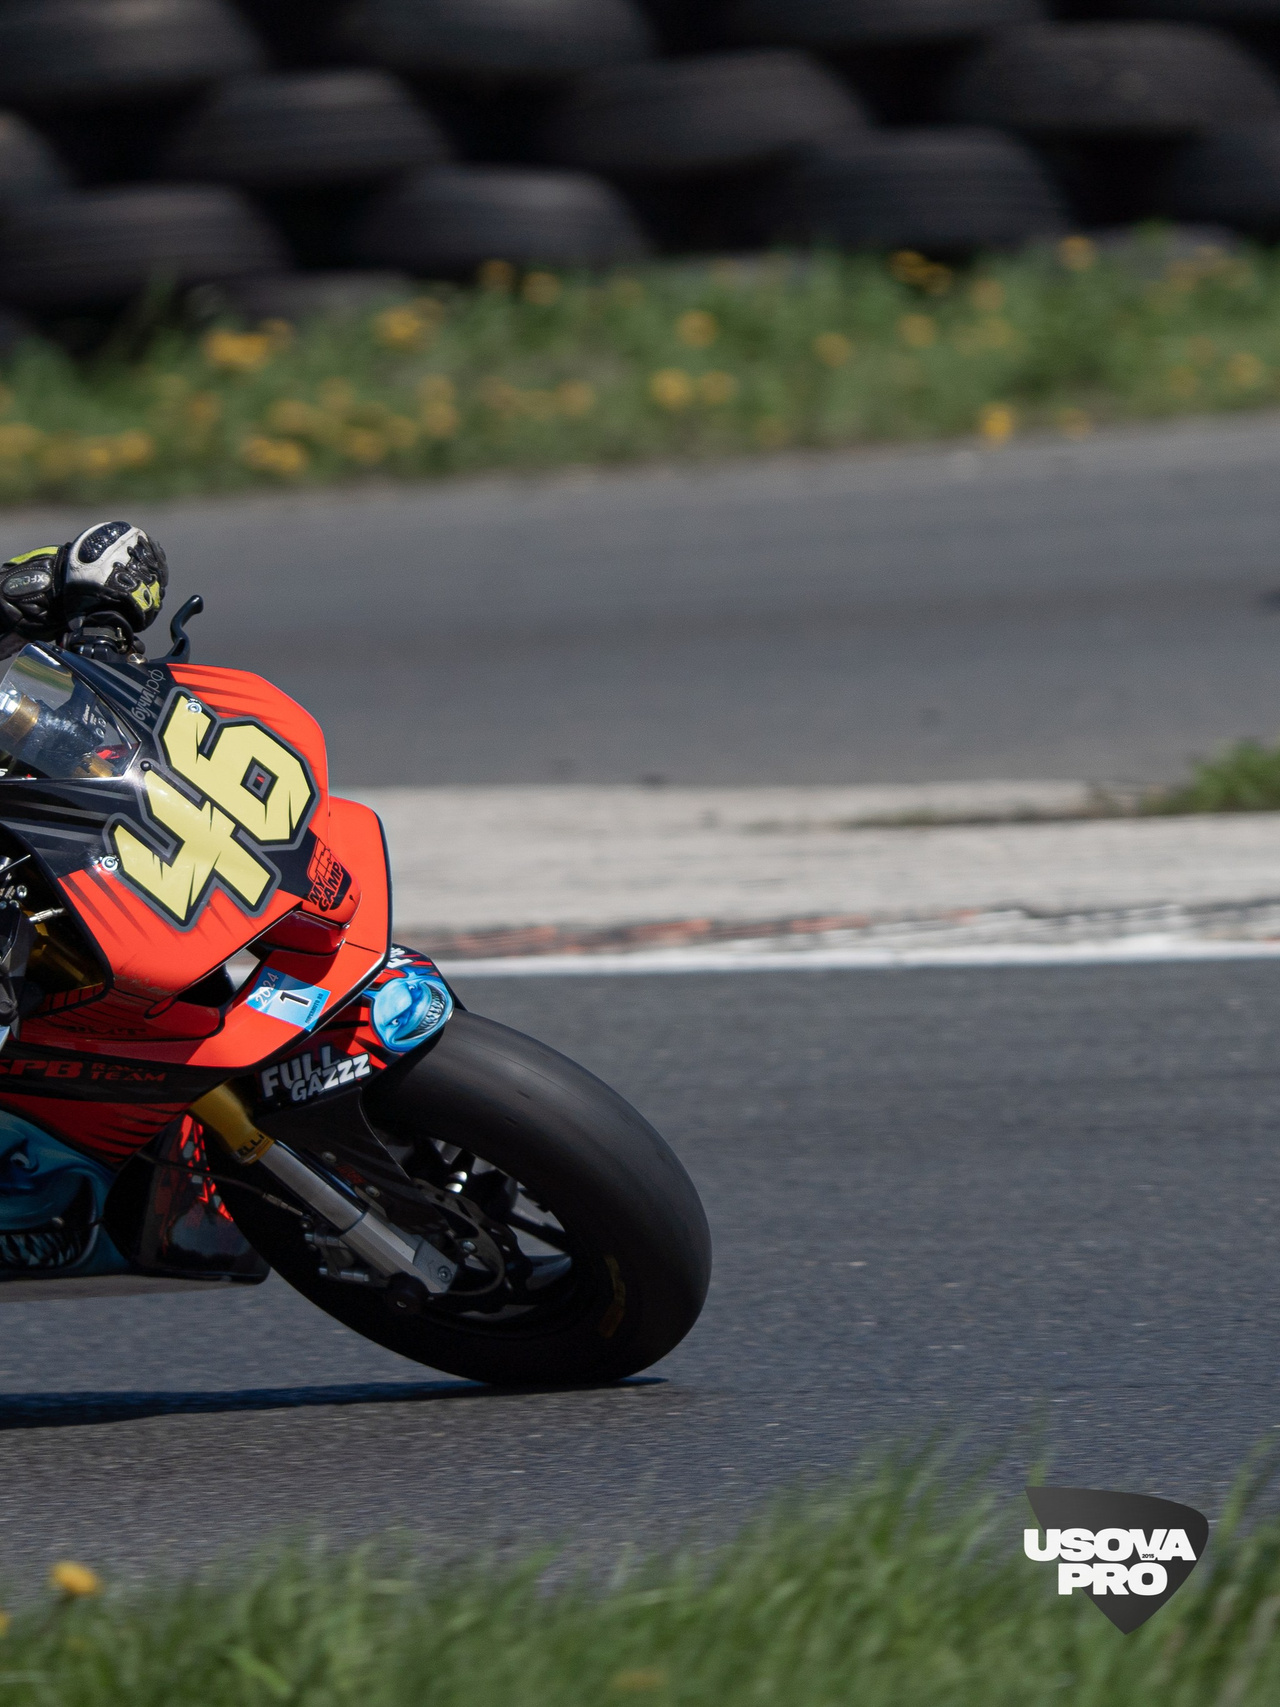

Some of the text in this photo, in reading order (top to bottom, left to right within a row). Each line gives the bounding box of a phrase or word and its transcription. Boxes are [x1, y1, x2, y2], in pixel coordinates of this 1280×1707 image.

[131, 669, 167, 720] бучи.рф
[113, 695, 312, 921] 46
[308, 874, 326, 905] MY
[318, 862, 342, 912] CAMP
[255, 972, 279, 1008] 2024
[279, 991, 311, 1006] 1
[91, 1071, 167, 1082] TEAM
[261, 1045, 340, 1098] FULL
[291, 1053, 371, 1101] GAZZZ
